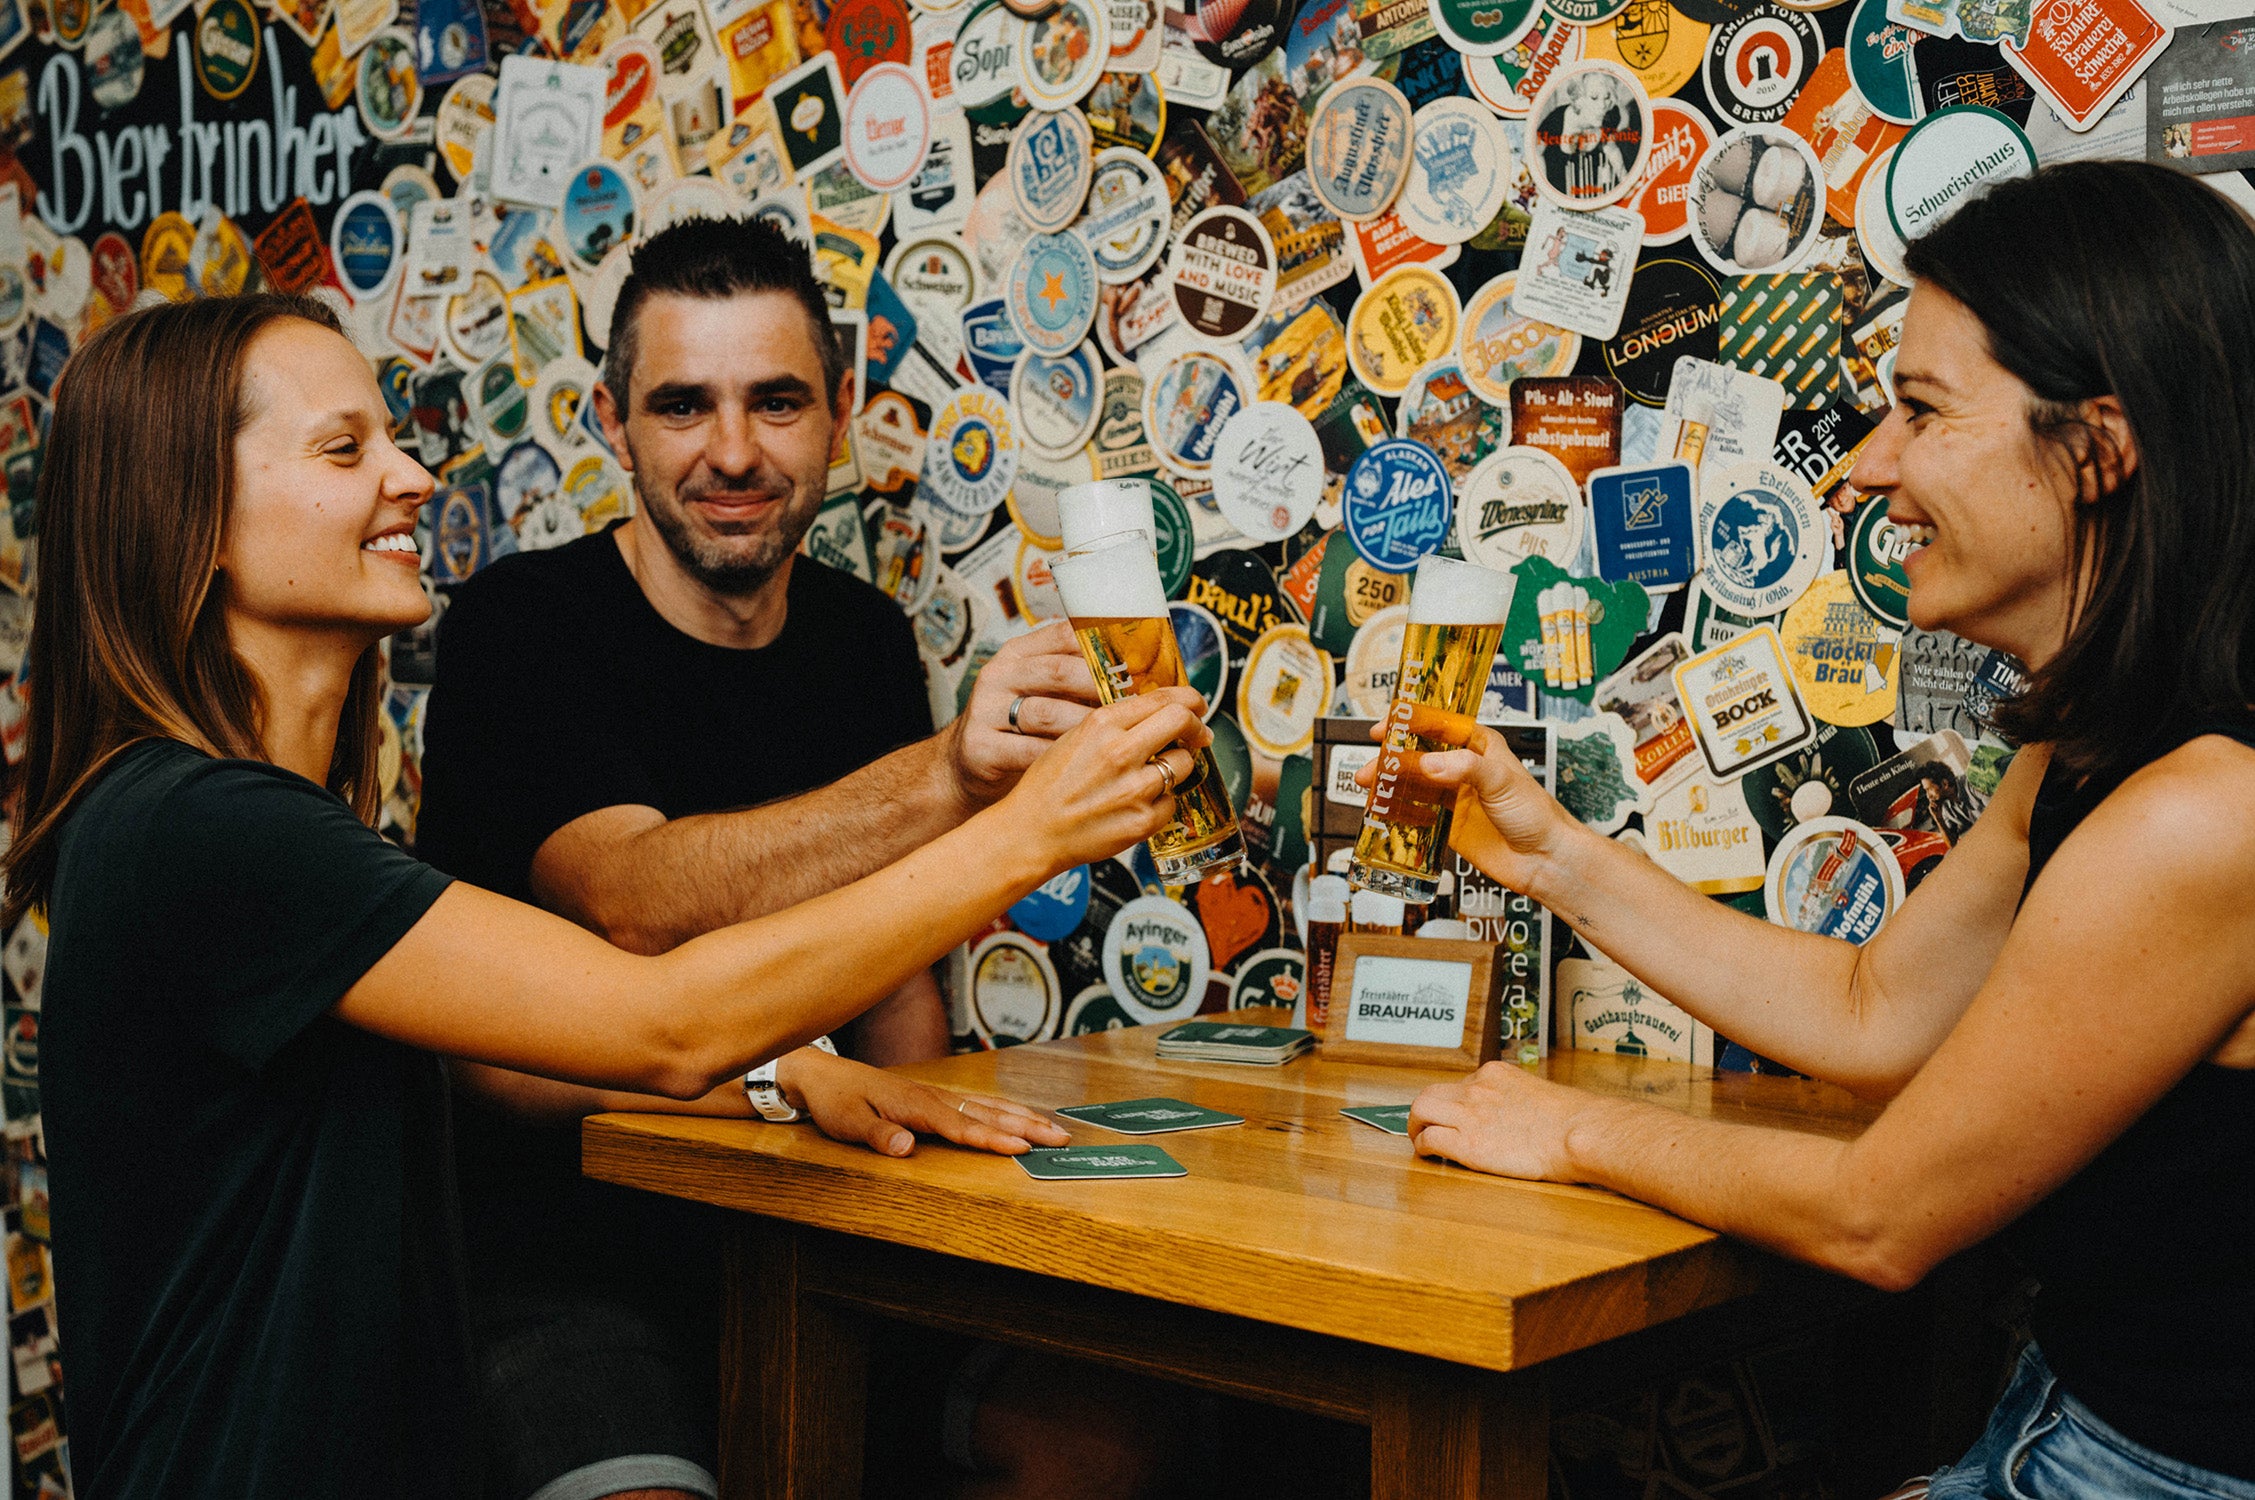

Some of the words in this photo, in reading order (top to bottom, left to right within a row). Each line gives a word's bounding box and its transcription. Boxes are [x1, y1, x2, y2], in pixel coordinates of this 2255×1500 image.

[1769, 3, 1810, 37] TOWN
[2062, 15, 2115, 69] Brauerei
[2074, 27, 2129, 85] Schwechat
[1755, 83, 1777, 95] 2010
[2162, 81, 2179, 94] weil
[2180, 81, 2192, 91] ich
[2193, 79, 2210, 90] sehr
[2211, 77, 2233, 88] nette
[2162, 89, 2223, 106] Arbeitskollegen
[2224, 86, 2244, 98] habe
[1732, 88, 1801, 122] BREWERY
[2162, 105, 2182, 117] mich
[2183, 103, 2196, 114] mit
[2196, 101, 2216, 113] allen
[1195, 233, 1258, 266] BREWED
[1185, 250, 1220, 272] WITH
[1224, 262, 1264, 286] LOVE
[1176, 267, 1209, 288] AND
[1213, 279, 1261, 305] MUSIC
[1524, 388, 1548, 406] Pils
[1556, 388, 1575, 407] Alt
[1583, 391, 1615, 408] Stout
[1525, 427, 1611, 451] selbstgebraut!
[1811, 408, 1843, 442] 2014
[1384, 449, 1431, 473] ALASKAN
[1378, 470, 1440, 511] Ales
[1363, 498, 1444, 559] Tails
[1627, 567, 1670, 581] AUSTRIA
[1357, 576, 1396, 603] 250
[1488, 671, 1523, 688] AMER
[1815, 661, 1863, 685] Bräu
[1912, 676, 1938, 689] Nicht
[1938, 680, 1954, 691] die
[1913, 664, 1932, 676] Wir
[1934, 666, 1964, 679] zählen
[1711, 688, 1777, 730] BOCK
[1636, 725, 1691, 771] KOBLEN
[1856, 778, 1879, 795] Heute
[1879, 772, 1891, 784] ein
[1656, 820, 1749, 852] Bitburger
[1459, 876, 1531, 912] birra
[1125, 920, 1189, 946] Ayinger
[1852, 901, 1883, 940] Hell
[1358, 1003, 1455, 1022] BRAUHAUS
[1583, 1009, 1683, 1043] Gasthausbrauerei
